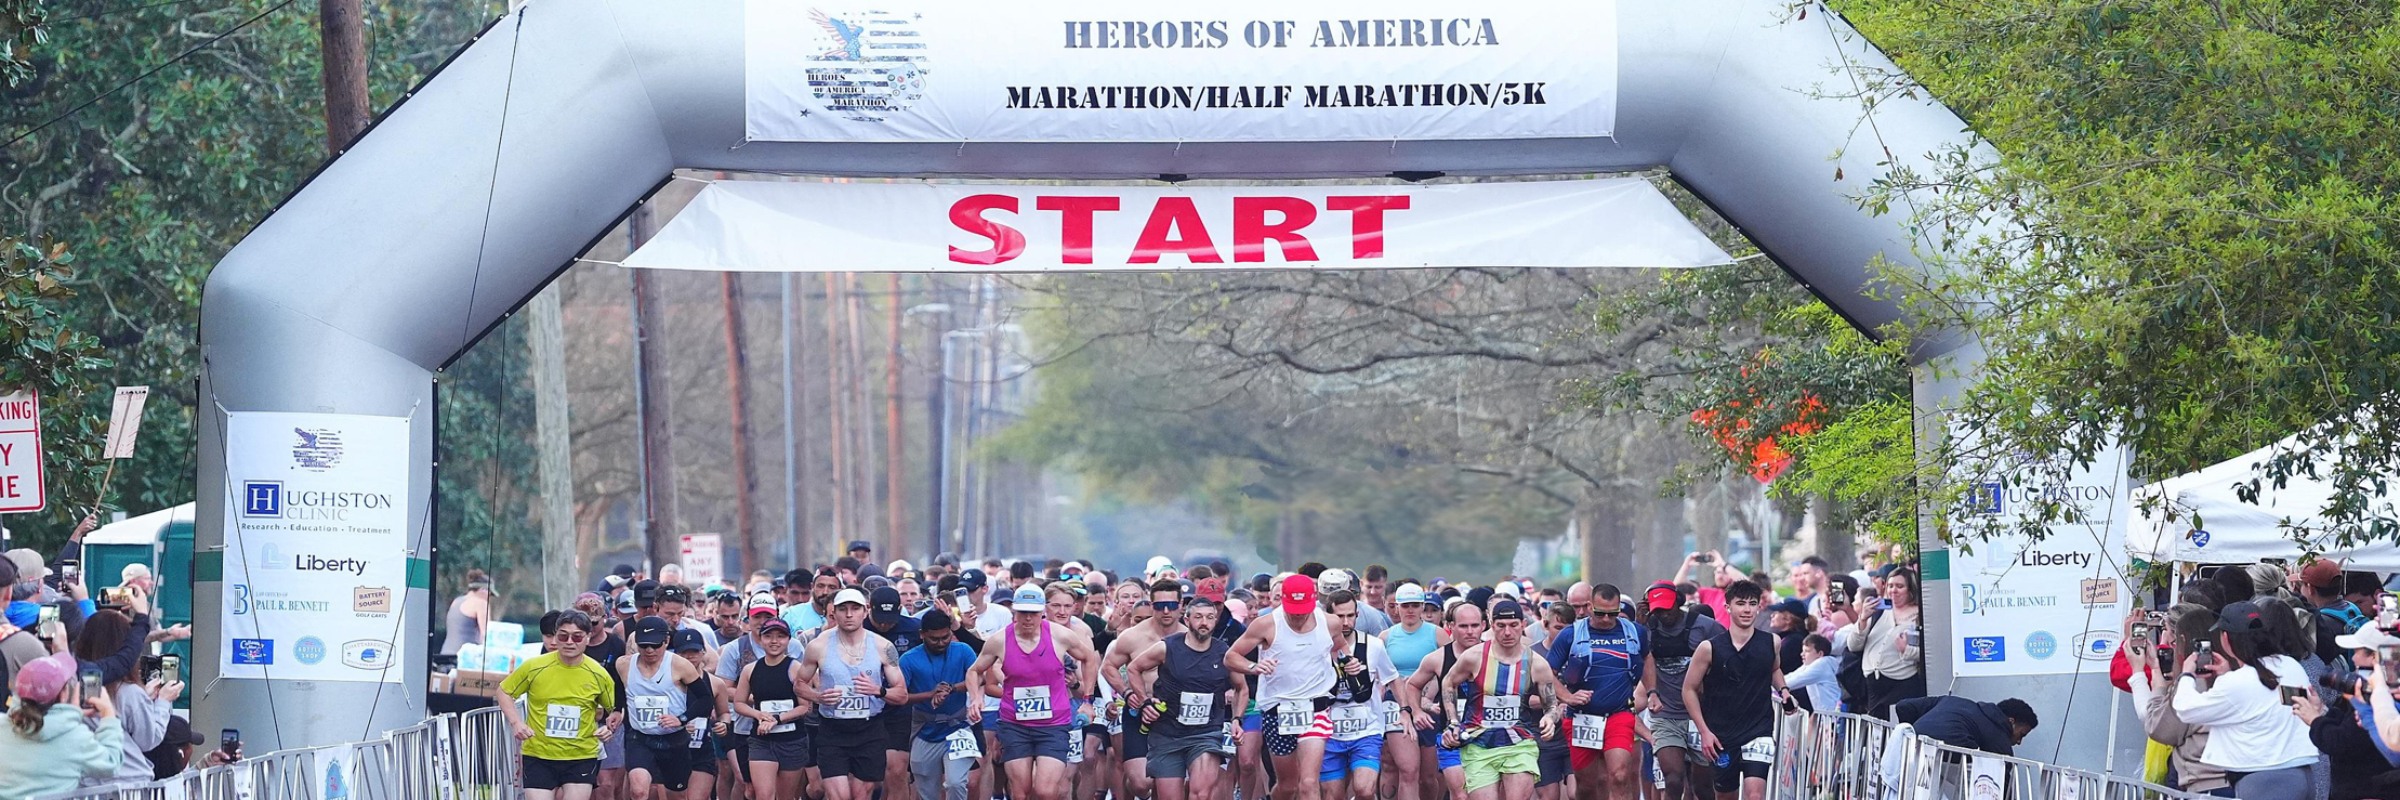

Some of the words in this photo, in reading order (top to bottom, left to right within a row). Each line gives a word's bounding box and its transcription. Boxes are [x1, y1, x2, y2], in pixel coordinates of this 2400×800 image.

[1063, 20, 1229, 49] HEROES
[1244, 20, 1295, 48] OF
[1310, 18, 1499, 47] AMERICA
[832, 98, 888, 106] MARATHON
[1006, 85, 1292, 111] MARATHON/HALF
[1304, 82, 1546, 109] MARATHON/5K
[948, 194, 1410, 266] START
[286, 507, 349, 521] CLINIC
[290, 524, 338, 533] Education
[348, 526, 391, 535] Treatment
[296, 554, 367, 576] Liberty
[2021, 551, 2092, 568] Liberty
[2085, 582, 2113, 592] BATTERY
[359, 591, 386, 600] BATTERY
[2085, 590, 2111, 599] SOURCE
[256, 599, 277, 611] PAUL
[278, 600, 287, 611] R.
[288, 600, 330, 612] BENNETT
[1985, 597, 2006, 608] PAUL
[2007, 597, 2016, 608] R.
[2017, 596, 2058, 607] BENNETT
[836, 697, 863, 710] 220
[1016, 698, 1044, 712] 327
[1181, 704, 1206, 718] 189
[1485, 708, 1514, 721] 358
[549, 716, 574, 731] 170
[1280, 711, 1307, 727] 211
[1335, 719, 1361, 733] 194
[1574, 726, 1598, 741] 176
[950, 739, 975, 751] 406
